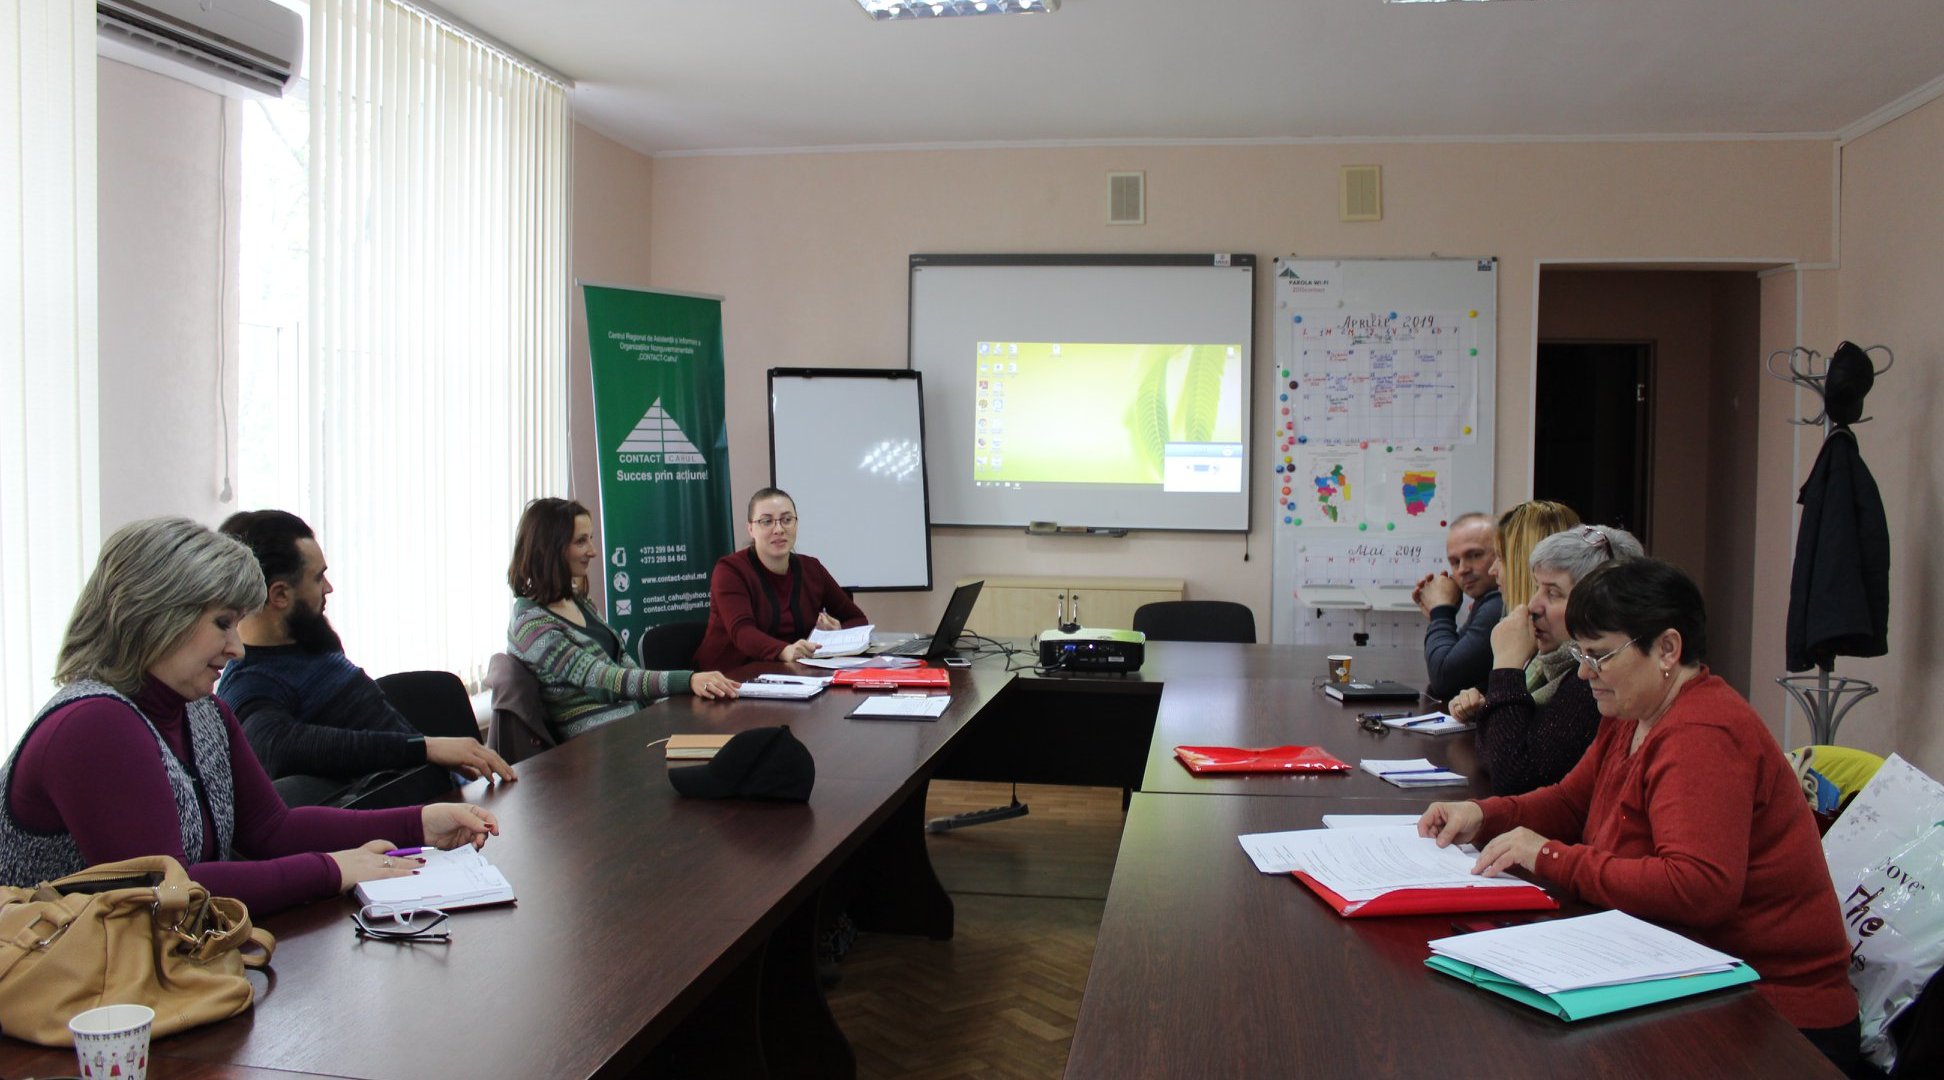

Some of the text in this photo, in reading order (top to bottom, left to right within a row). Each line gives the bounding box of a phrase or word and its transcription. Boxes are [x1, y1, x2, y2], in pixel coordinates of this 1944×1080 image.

[619, 454, 697, 464] CONTACT CAHUL
[616, 469, 652, 481] Succes
[655, 470, 673, 483] prin
[640, 546, 655, 554] +373
[1348, 544, 1422, 559] Mai 2019
[640, 555, 655, 564] +373
[641, 572, 707, 584] www.contact-cahul.md
[643, 592, 711, 604] contact_cahul@yahoo.c
